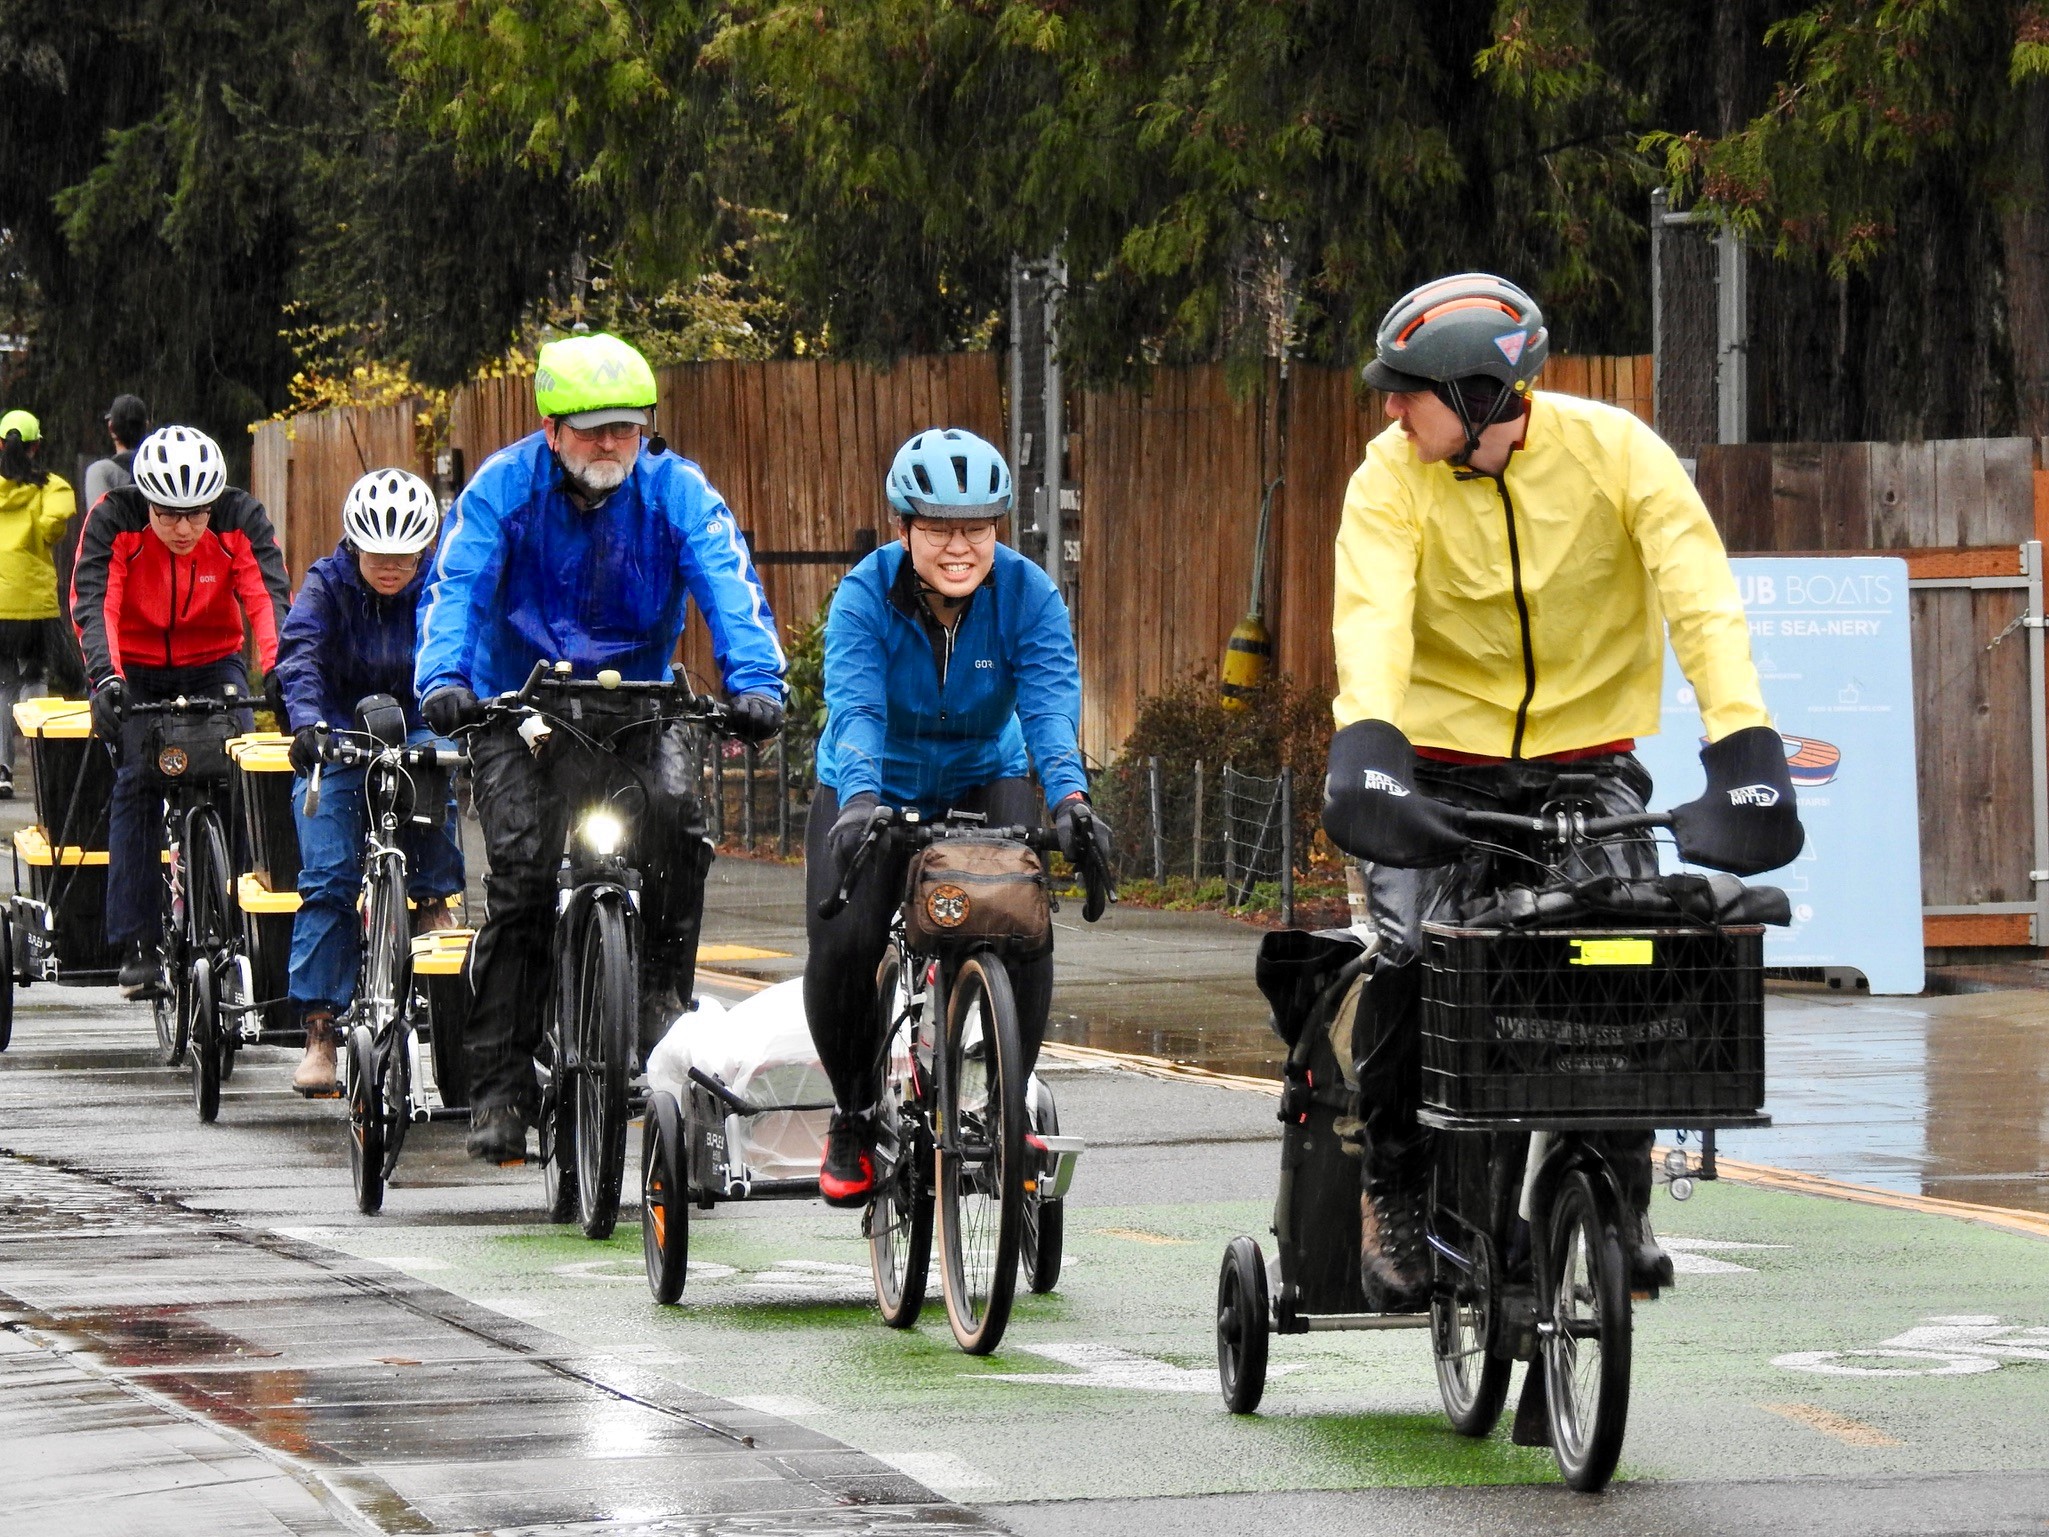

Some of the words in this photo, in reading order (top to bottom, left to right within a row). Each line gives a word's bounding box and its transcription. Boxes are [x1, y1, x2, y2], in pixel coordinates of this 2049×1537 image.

[1736, 576, 1776, 605] UB
[1785, 575, 1892, 605] BOATS
[1750, 620, 1774, 636] HE
[1780, 620, 1881, 636] SEA-NERY
[974, 659, 997, 669] GOR
